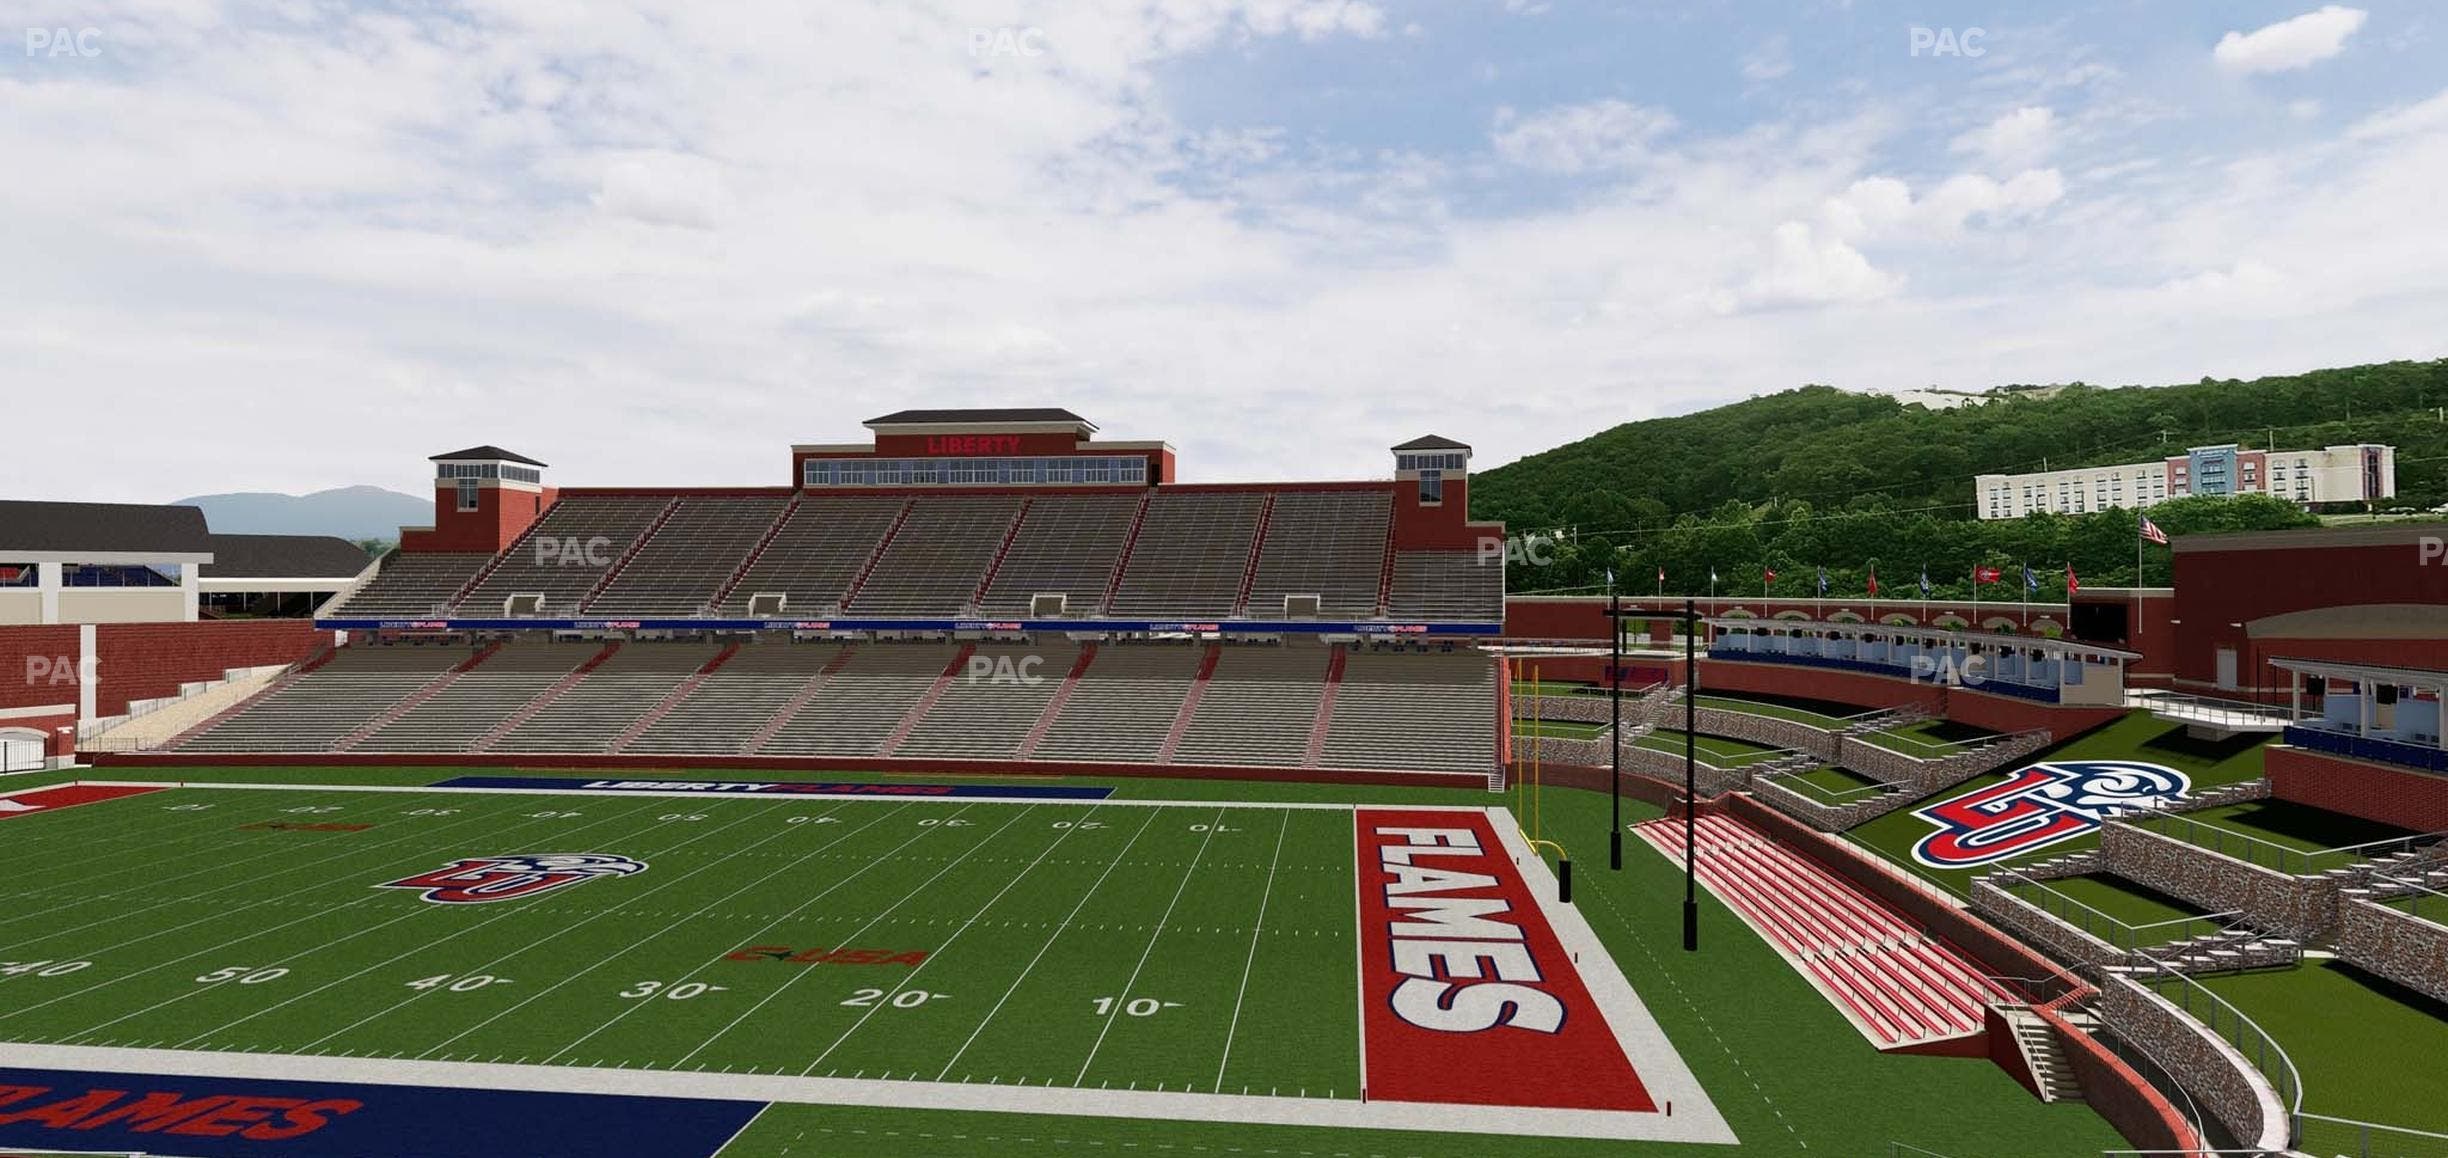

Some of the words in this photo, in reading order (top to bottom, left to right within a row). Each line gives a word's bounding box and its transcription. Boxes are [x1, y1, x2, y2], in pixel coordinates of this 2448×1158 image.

[927, 435, 1020, 455] LIBERTY
[1373, 826, 1569, 1034] FLAMES
[195, 966, 291, 984] 50
[404, 974, 495, 992] 40
[619, 981, 708, 1000] 30
[840, 989, 931, 1009] 20
[1092, 997, 1161, 1017] 10
